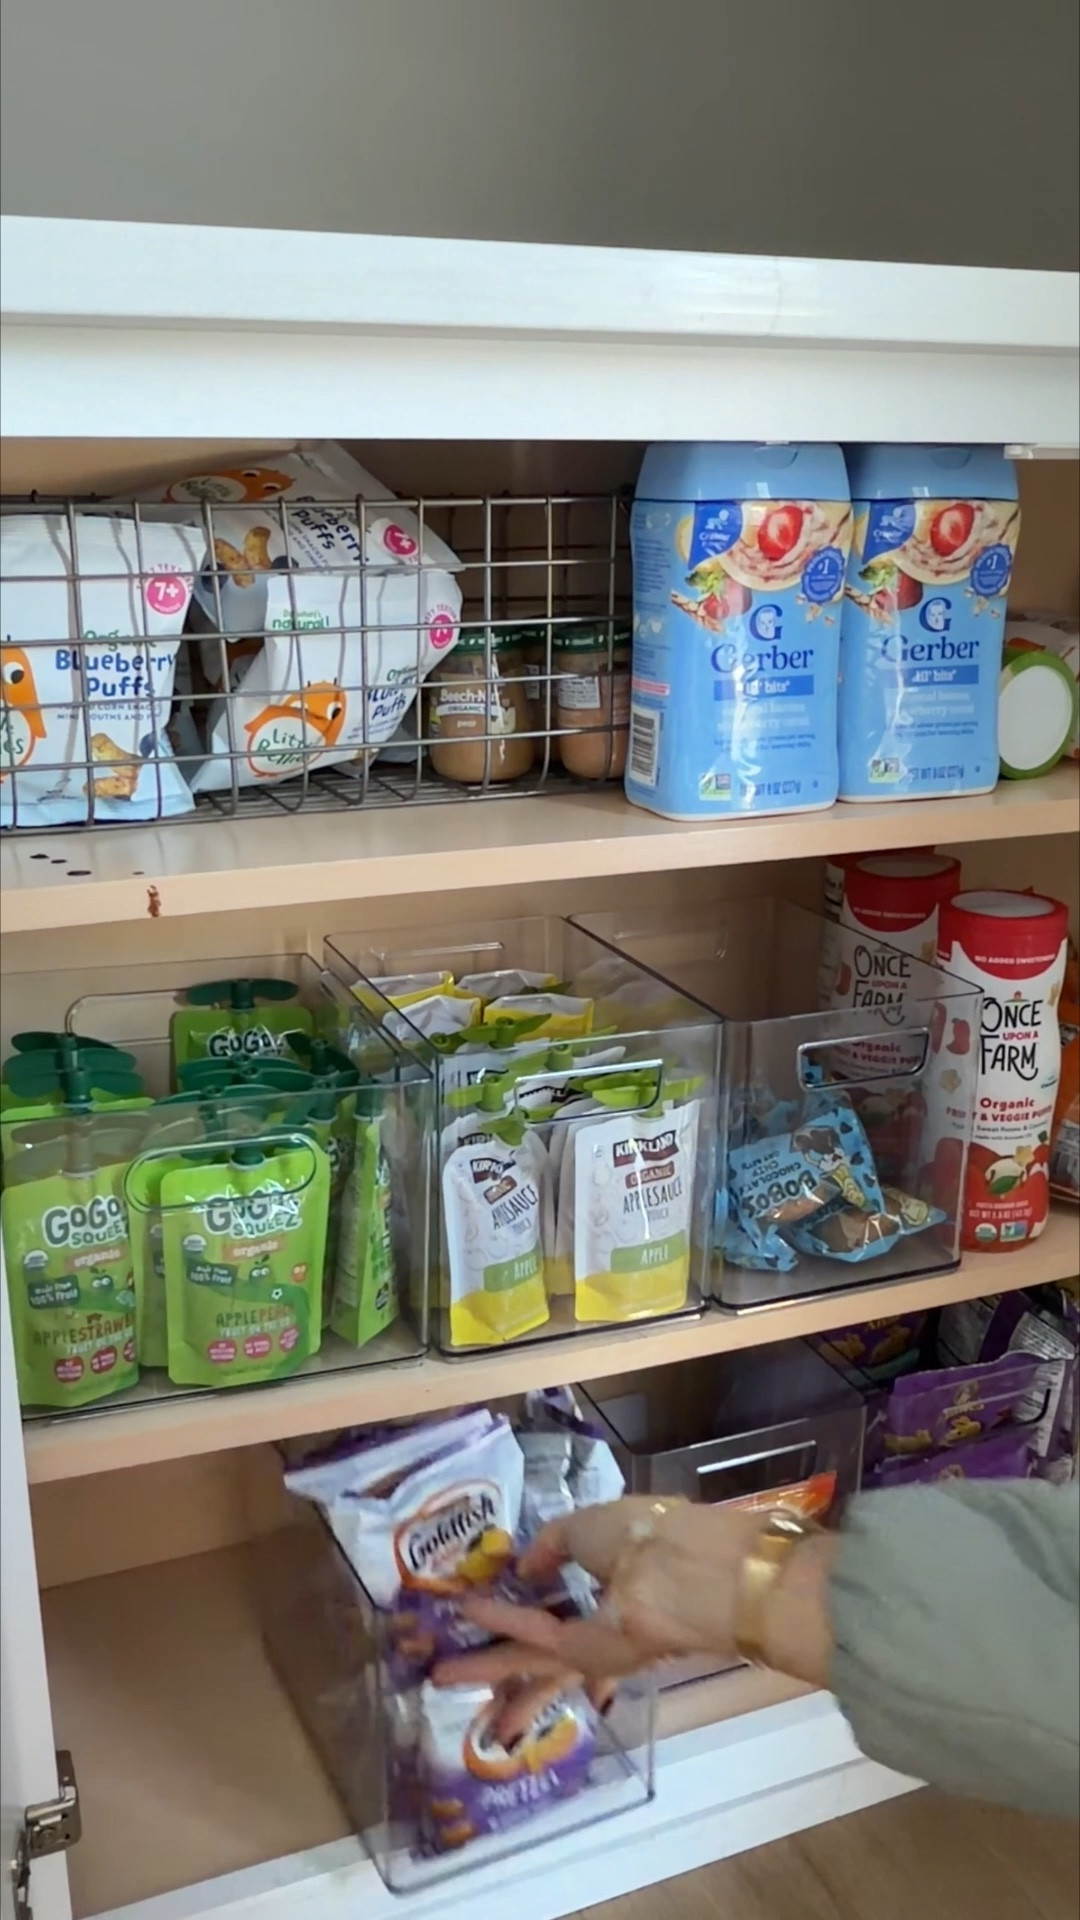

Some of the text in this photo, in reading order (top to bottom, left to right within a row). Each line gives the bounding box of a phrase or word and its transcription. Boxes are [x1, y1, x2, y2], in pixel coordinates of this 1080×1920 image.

[154, 581, 179, 602] 7+
[711, 645, 814, 674] Gerber
[881, 635, 980, 663] Gerber
[86, 676, 155, 699] Puffs
[854, 944, 911, 979] ONCE
[981, 996, 1043, 1032] ONCE
[1002, 1030, 1039, 1041] UPON A
[979, 1033, 1039, 1081] FARM
[979, 1096, 1035, 1112] Organic
[991, 1111, 1030, 1122] VEGGIE
[615, 1133, 674, 1157] KIRKLAND
[623, 1176, 683, 1214] APPLESAUCE
[45, 1197, 121, 1246] GoGo
[73, 1249, 122, 1268] organic
[233, 1239, 279, 1258] organic
[640, 1244, 669, 1265] APPLE
